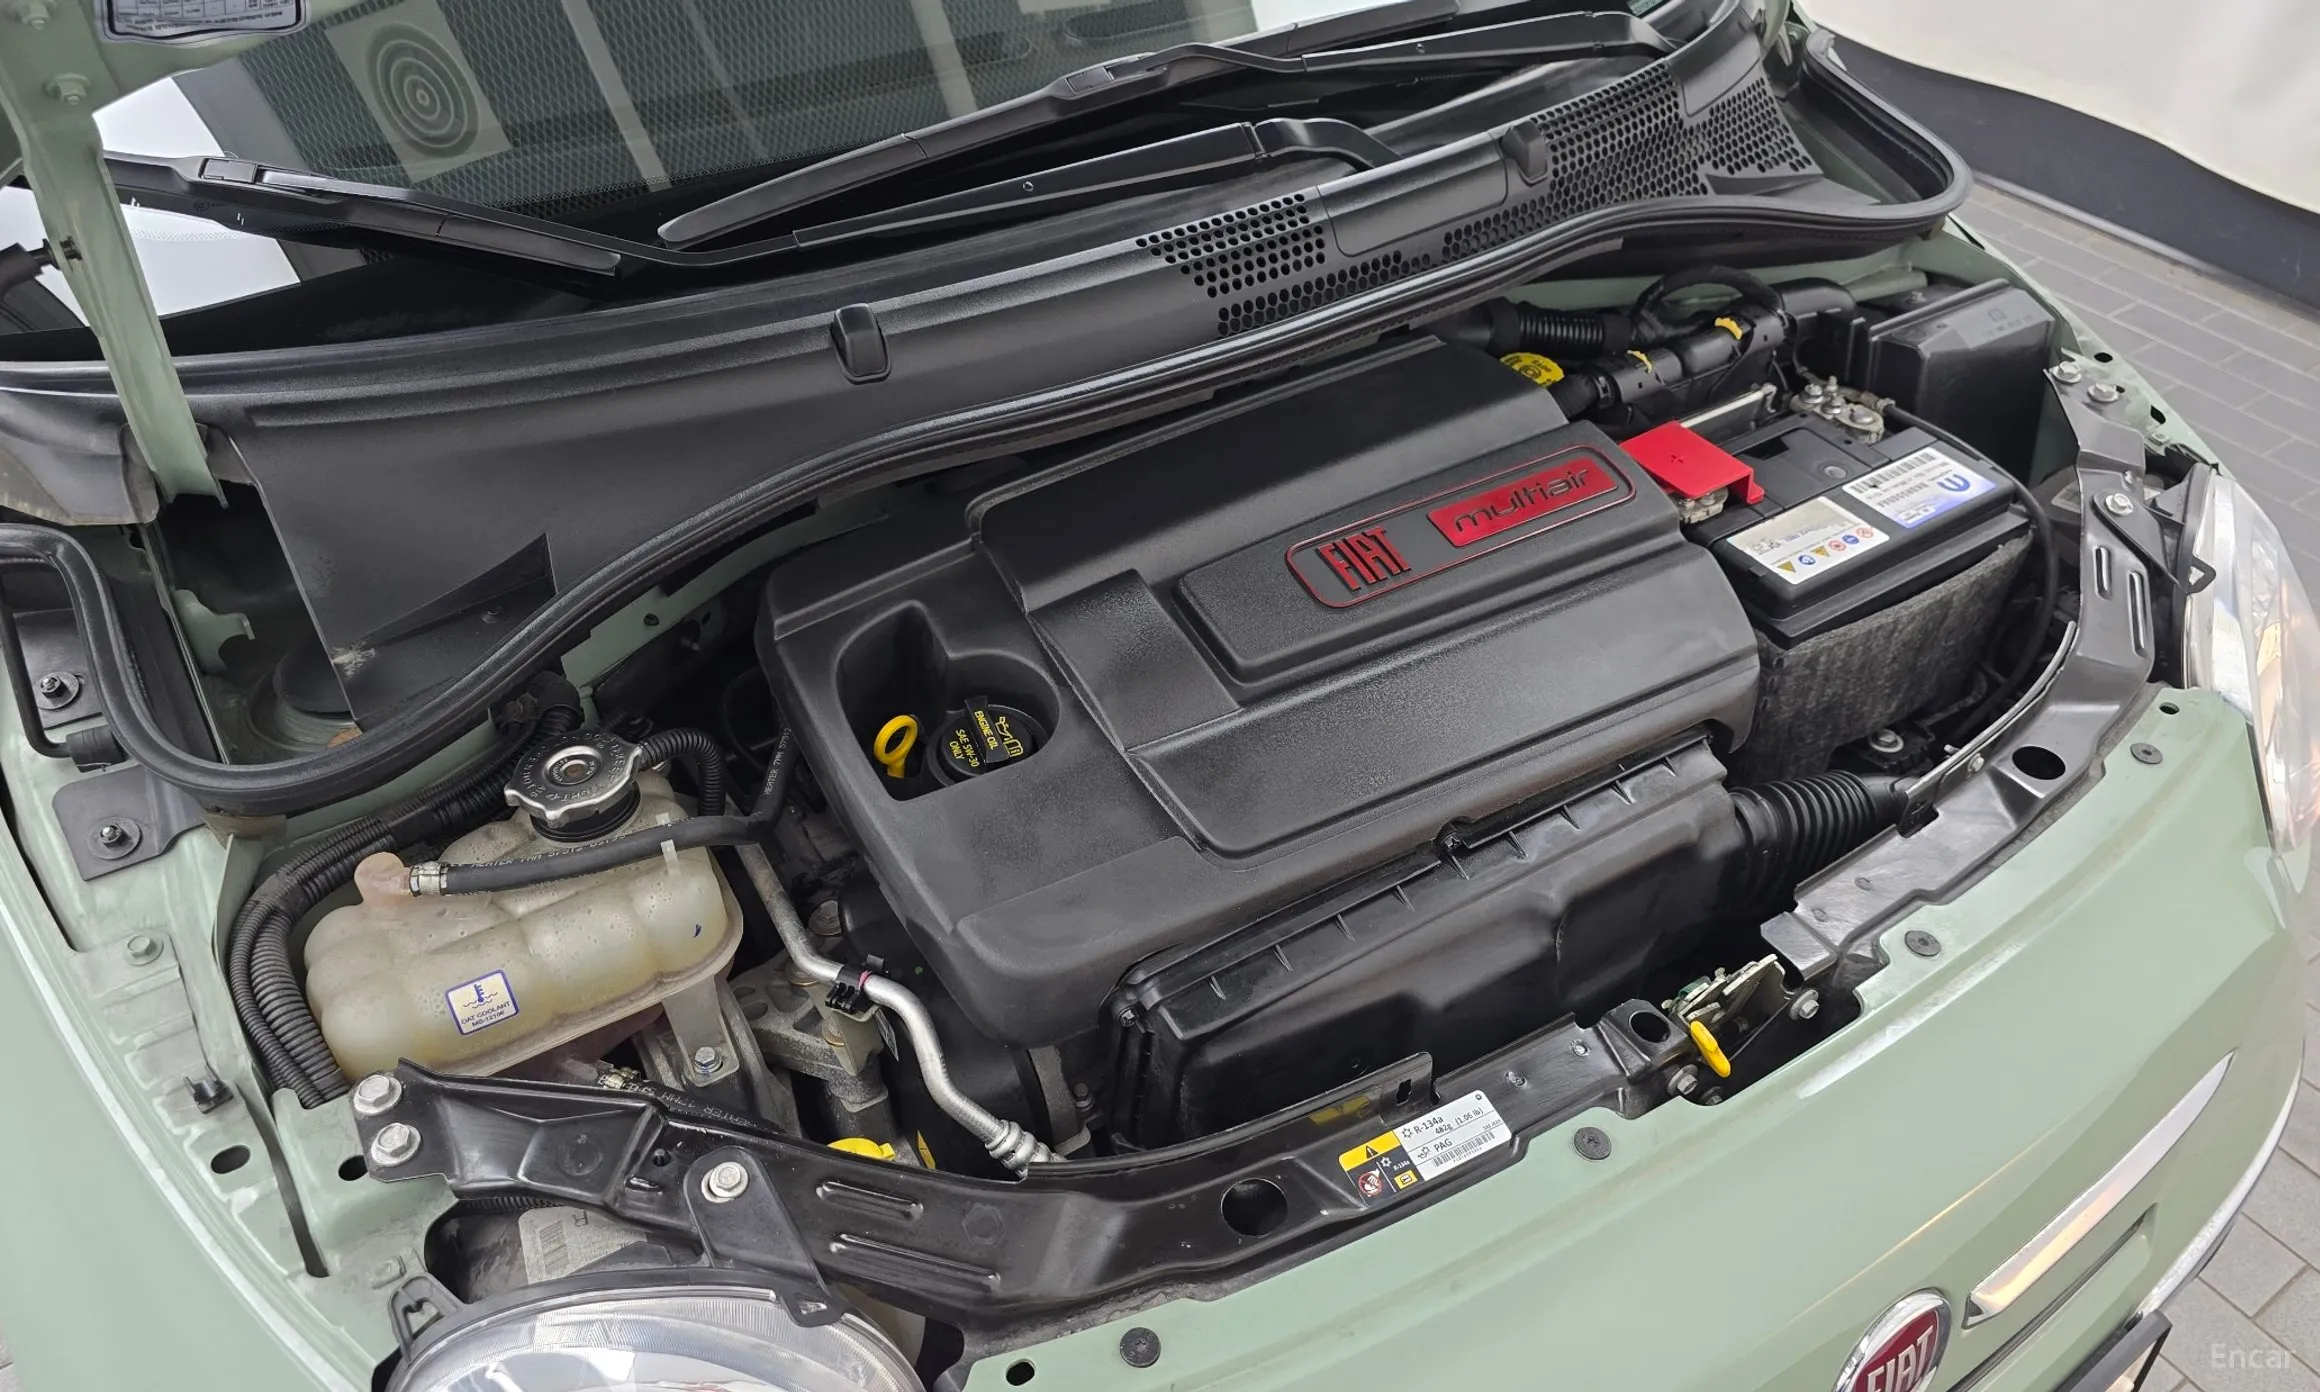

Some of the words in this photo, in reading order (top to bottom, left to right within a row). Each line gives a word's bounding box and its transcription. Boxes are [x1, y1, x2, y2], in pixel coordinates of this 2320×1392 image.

[1315, 524, 1411, 591] FIAT
[1454, 468, 1588, 533] multiair
[974, 711, 993, 737] ENGINE
[986, 736, 999, 751] OIL
[949, 740, 966, 760] ONLY
[956, 729, 970, 744] SAE
[963, 744, 980, 767] 5W-30
[460, 1014, 476, 1025] OAT
[476, 1001, 511, 1018] COOLANT
[1413, 1116, 1444, 1135] R-134a
[1435, 1124, 1454, 1136] 482g
[1473, 1107, 1484, 1118] lb)
[1433, 1137, 1454, 1153] PAG
